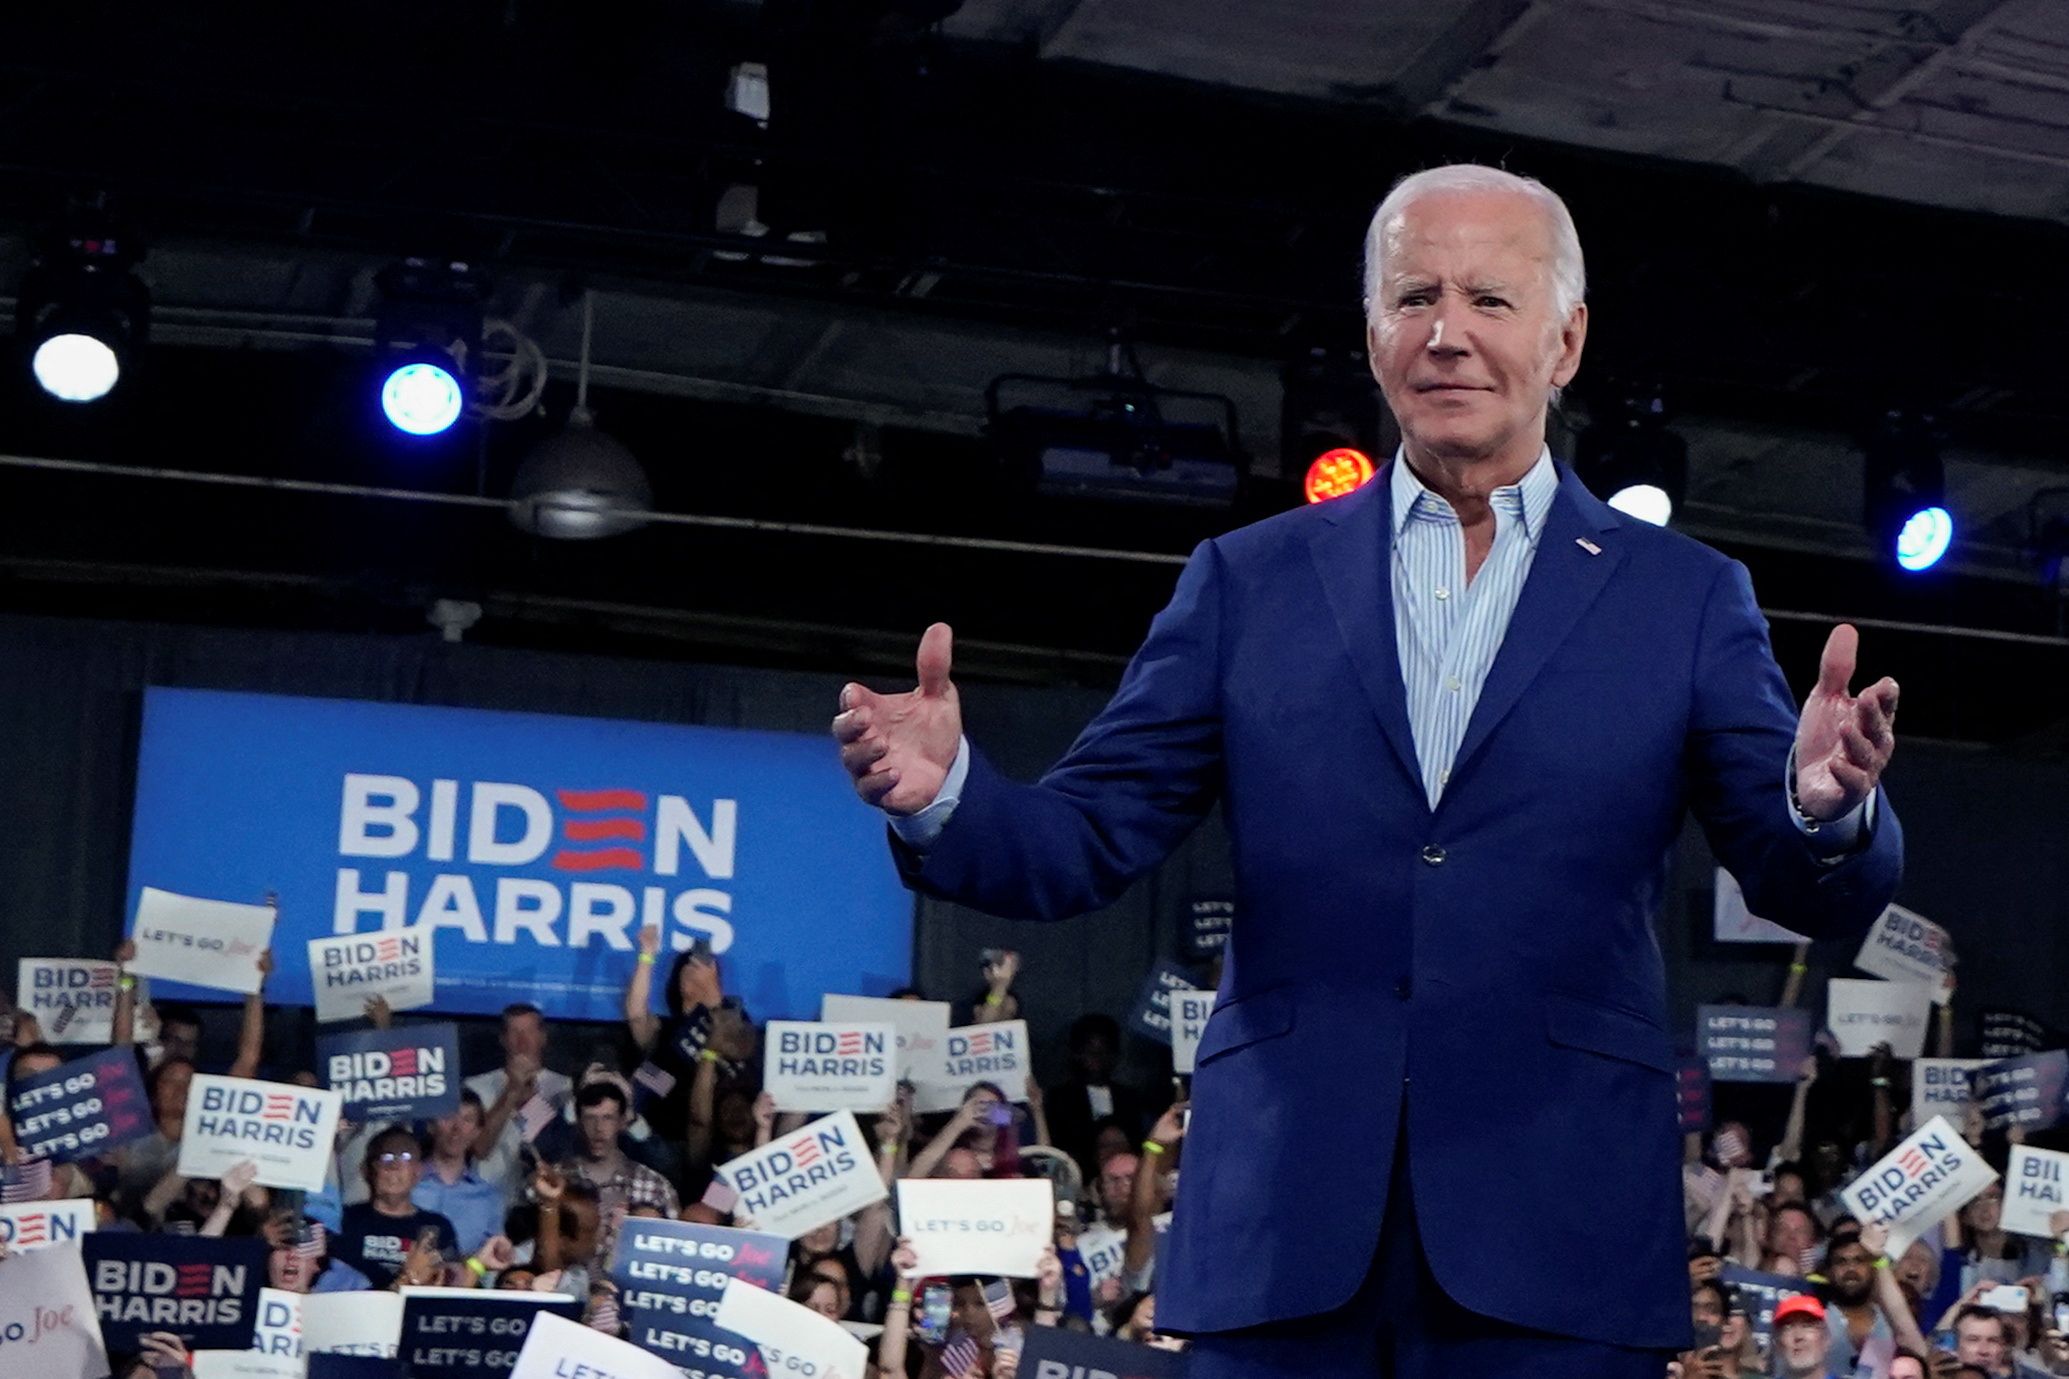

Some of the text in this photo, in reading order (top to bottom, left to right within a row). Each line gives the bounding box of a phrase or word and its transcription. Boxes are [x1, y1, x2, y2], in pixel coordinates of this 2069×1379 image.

[338, 772, 738, 880] BIDEN
[332, 867, 735, 954] HARRIS
[324, 934, 420, 967] BIDEN
[327, 958, 421, 988] HARRIS
[780, 1031, 884, 1055] BIDEN
[328, 1047, 447, 1082] BIDEN
[778, 1057, 885, 1076] HARRIS
[65, 1072, 96, 1094] GO
[330, 1073, 447, 1103] HARRIS
[72, 1097, 103, 1119] GO
[203, 1086, 322, 1125] BIDEN
[79, 1122, 110, 1144] GO
[198, 1115, 315, 1149] HARRIS
[733, 1125, 847, 1192] BIDEN
[1857, 1133, 1947, 1211] BIDEN
[744, 1151, 856, 1214] HARRIS
[1874, 1153, 1962, 1226] HARRIS
[914, 1219, 970, 1232] LET'S
[975, 1219, 1005, 1232] GO
[633, 1233, 698, 1257] LET'S
[699, 1242, 735, 1263] GO
[95, 1258, 247, 1298] BIDEN
[629, 1260, 692, 1285] LET'S
[694, 1270, 729, 1290] GO
[97, 1294, 242, 1326] HARRIS
[624, 1289, 687, 1314] LET'S
[417, 1315, 527, 1336] LET'S GO
[412, 1347, 481, 1367] LET'S
[646, 1328, 710, 1359] LET'S
[712, 1344, 746, 1366] GO
[785, 1356, 816, 1377] GO
